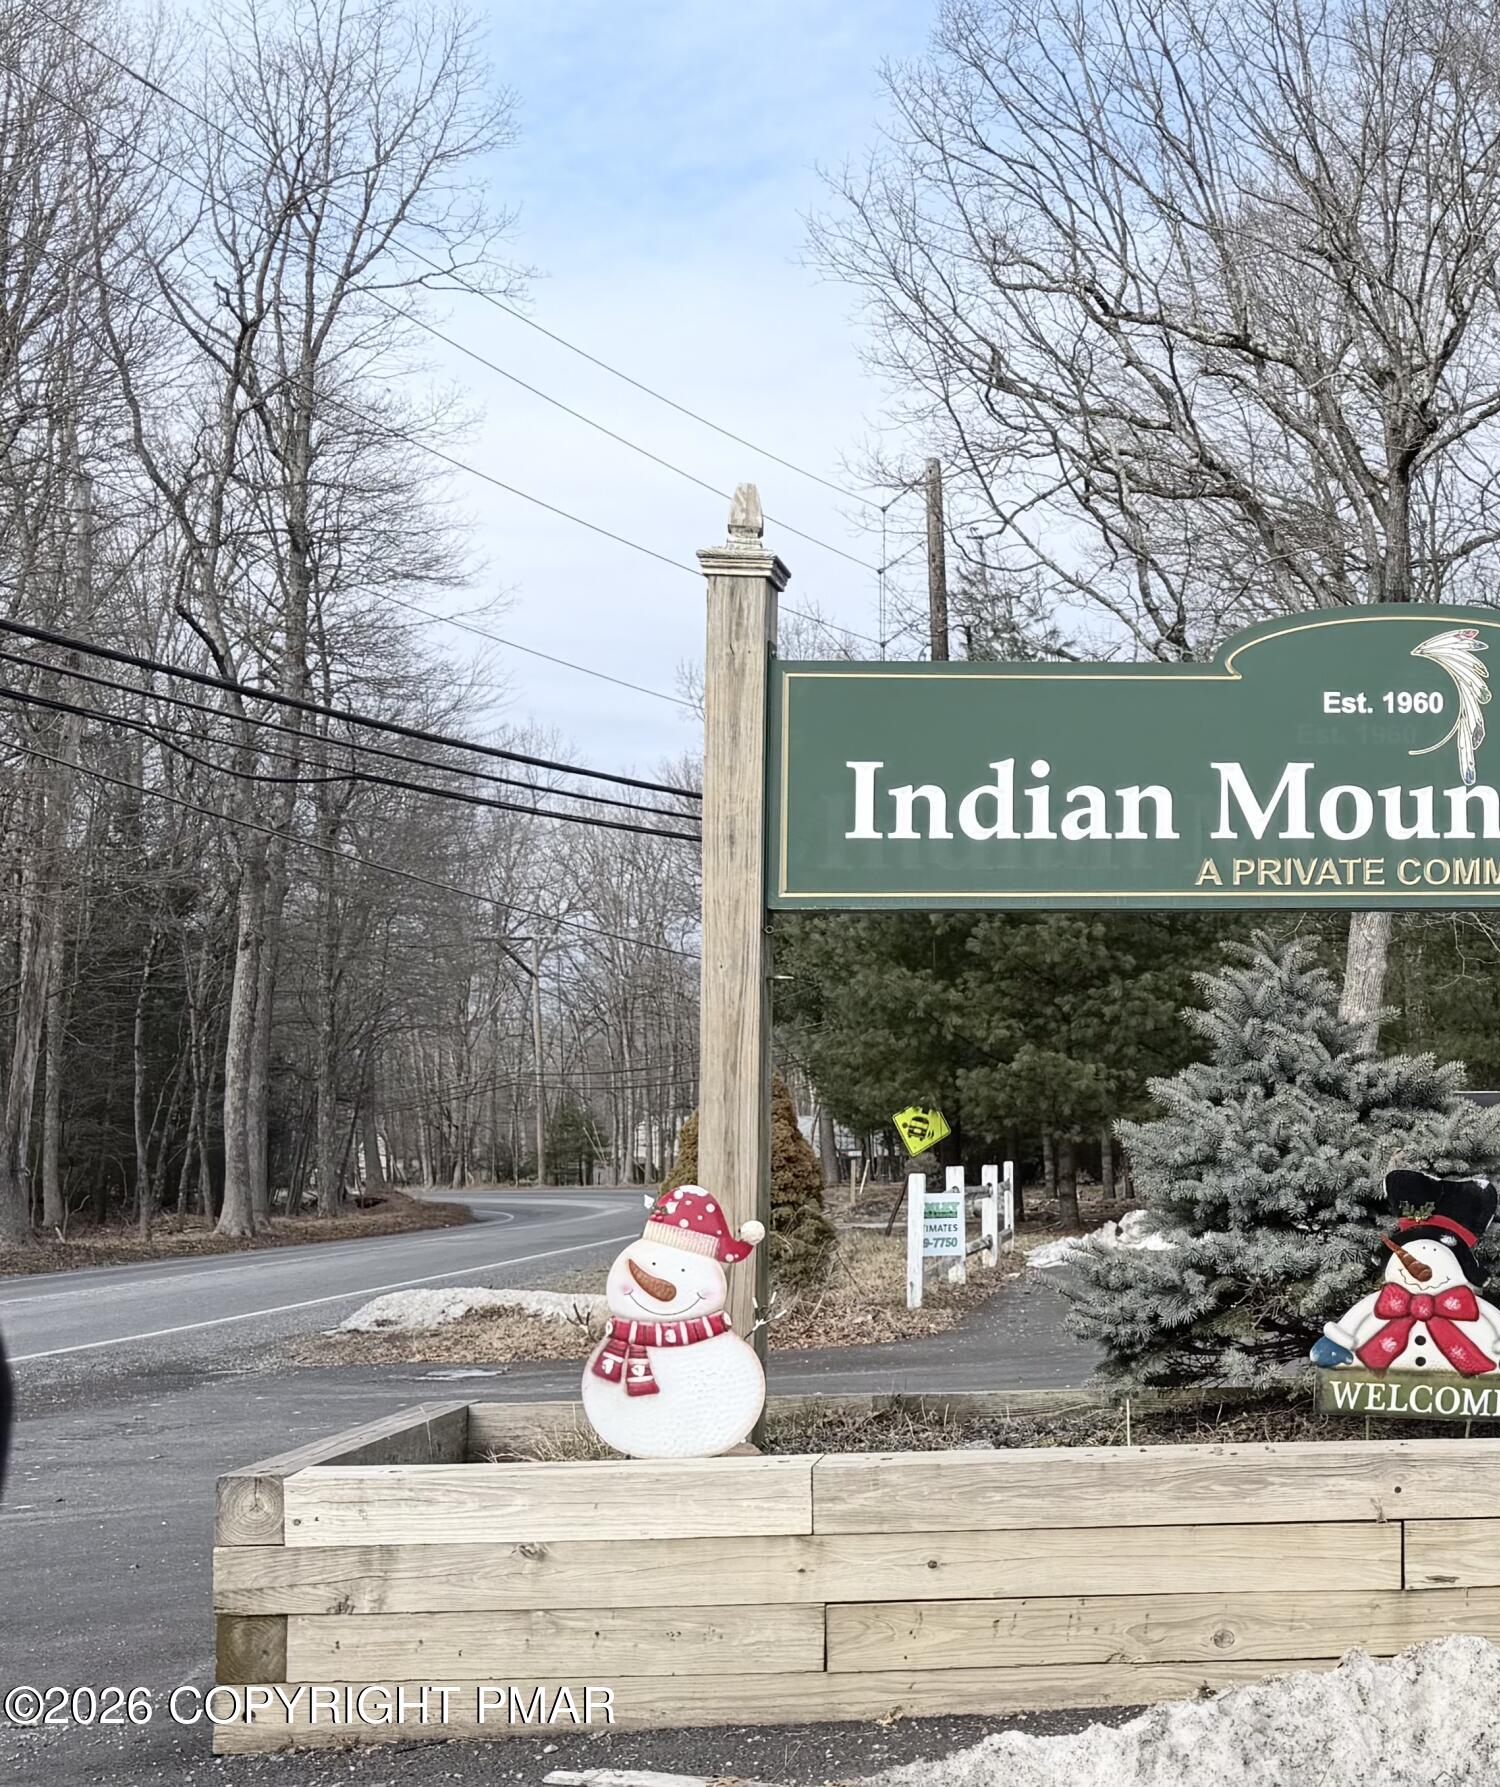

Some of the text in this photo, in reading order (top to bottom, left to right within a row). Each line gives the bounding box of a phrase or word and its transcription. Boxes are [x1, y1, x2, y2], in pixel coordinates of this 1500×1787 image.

[1323, 691, 1444, 714] Est. 1960
[845, 758, 1180, 841] Indian
[1195, 858, 1223, 886] A
[1232, 857, 1386, 886] PRIVATE
[924, 1223, 958, 1232] IMATES
